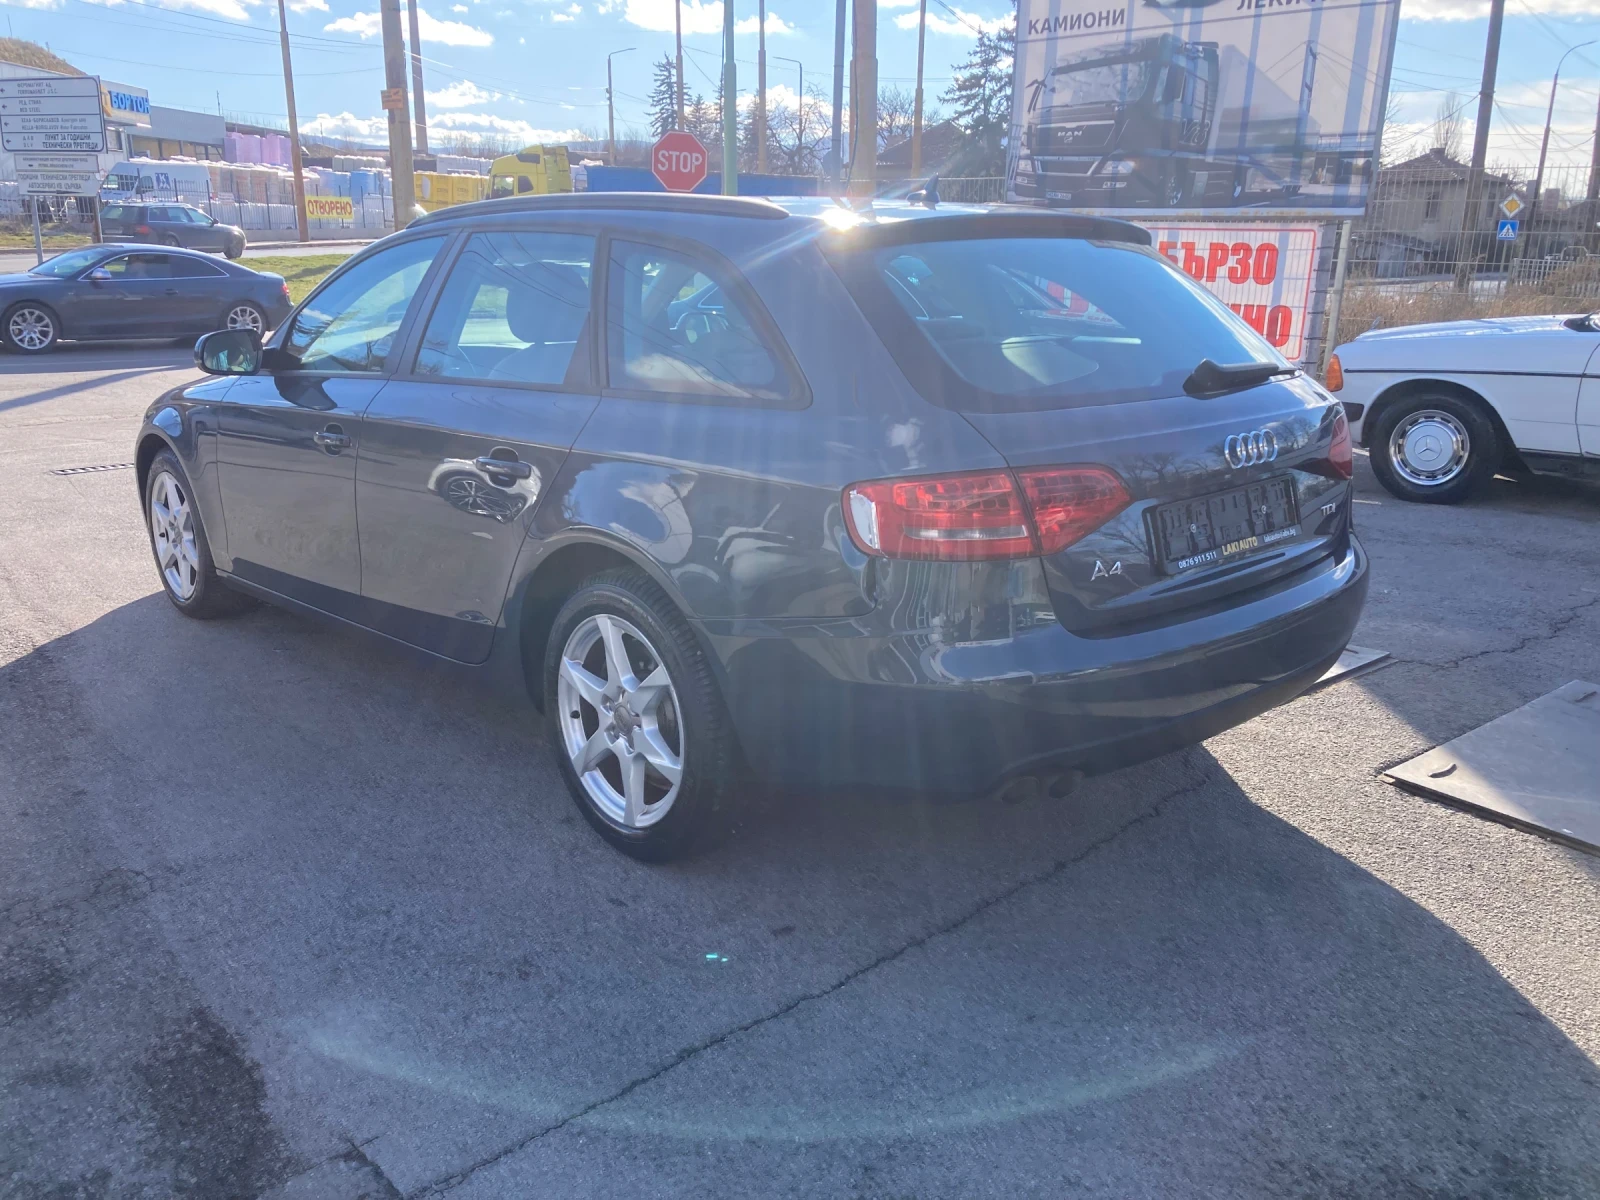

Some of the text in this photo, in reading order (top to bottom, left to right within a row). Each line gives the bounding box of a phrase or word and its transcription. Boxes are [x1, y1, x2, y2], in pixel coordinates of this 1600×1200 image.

[1028, 8, 1125, 35] КАМИОНИ
[111, 91, 150, 114] БОРТОН
[42, 141, 99, 150] ТЕХНИЧЕСКИ ПРЕГЛЕДИ
[44, 133, 91, 142] ПУНКТ ЗА ГОДИШНИ
[657, 150, 703, 174] STOP
[307, 199, 352, 216] ОТВОРЕНО
[1158, 240, 1279, 286] БЪРЗО
[1320, 502, 1336, 516] TDI
[1221, 536, 1258, 556] LAKI AUTO
[1090, 560, 1123, 581] A4
